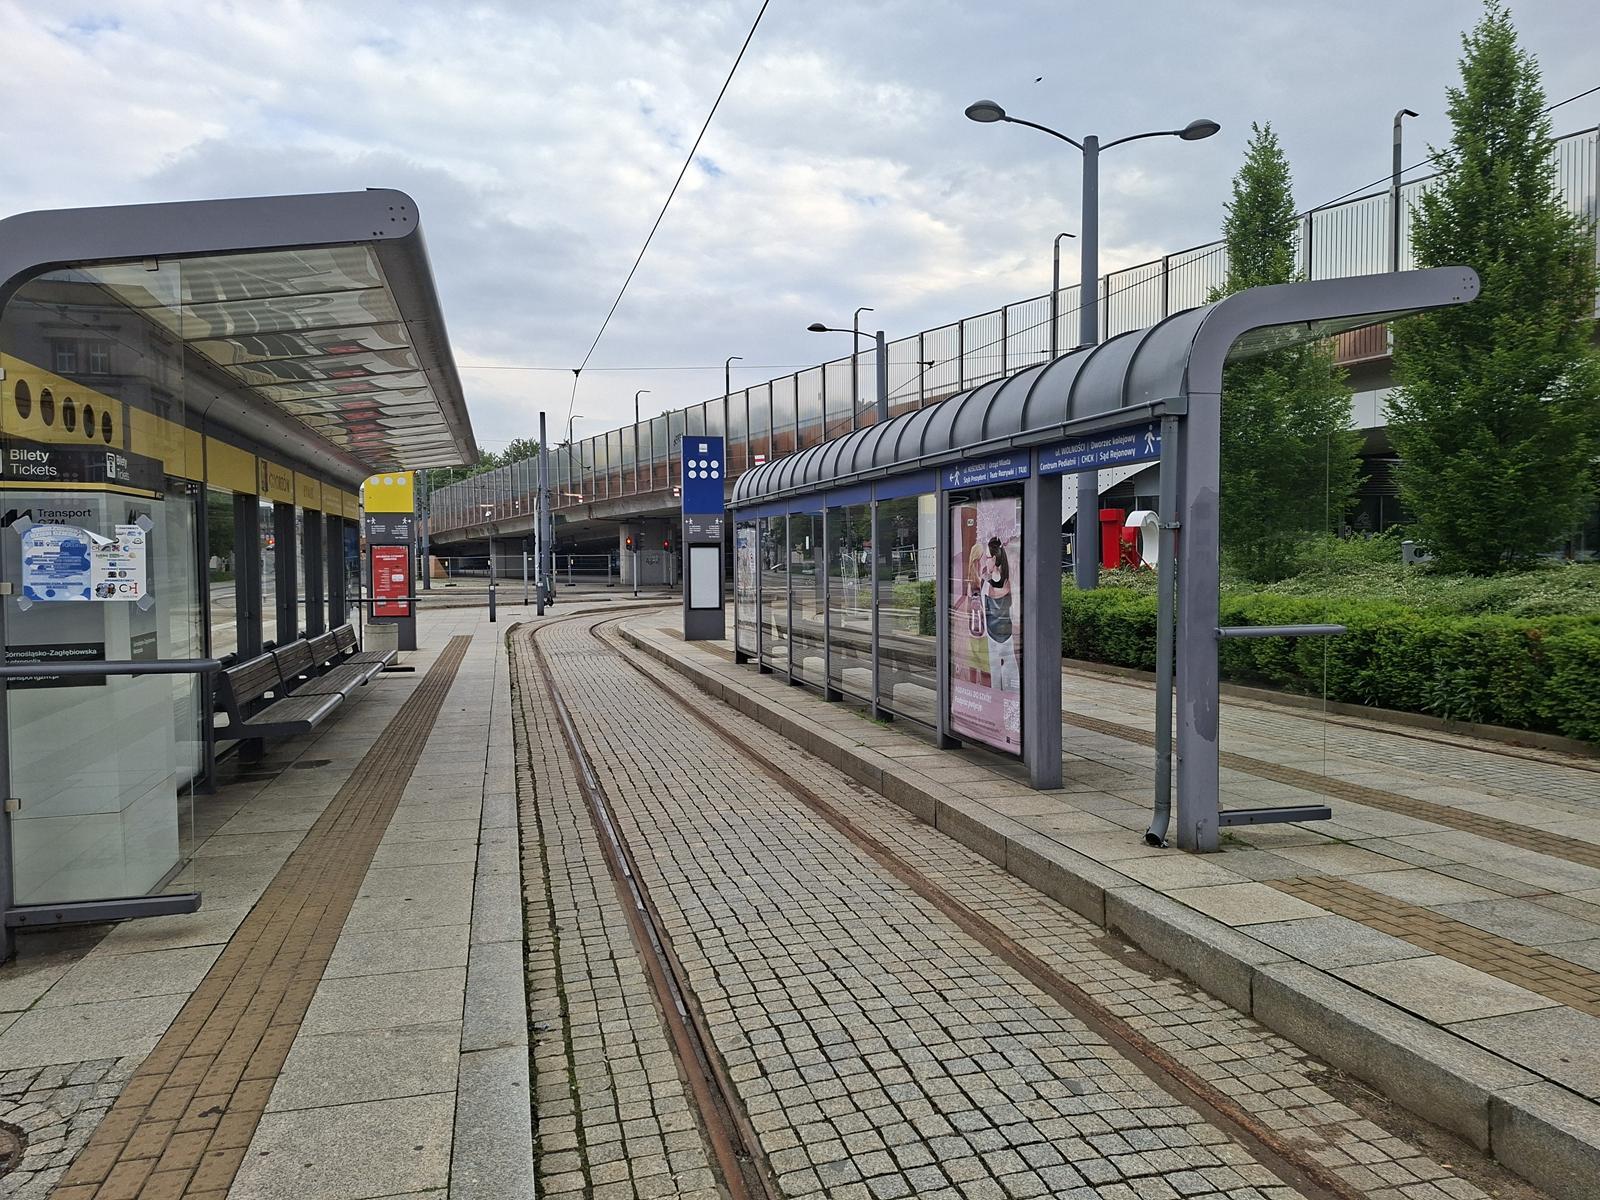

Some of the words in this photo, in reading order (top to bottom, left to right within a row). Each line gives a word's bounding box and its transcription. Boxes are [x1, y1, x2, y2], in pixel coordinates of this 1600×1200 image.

[1061, 442, 1086, 456] WOLNOŚCI
[1091, 439, 1111, 450] Dworzec
[1112, 434, 1136, 446] kolejowy
[10, 449, 50, 463] Bilety
[1040, 460, 1058, 471] Centrum
[1099, 451, 1110, 461] Sąd
[1110, 448, 1136, 460] Rejonowy
[10, 463, 57, 476] Tickets
[37, 508, 92, 519] Transport
